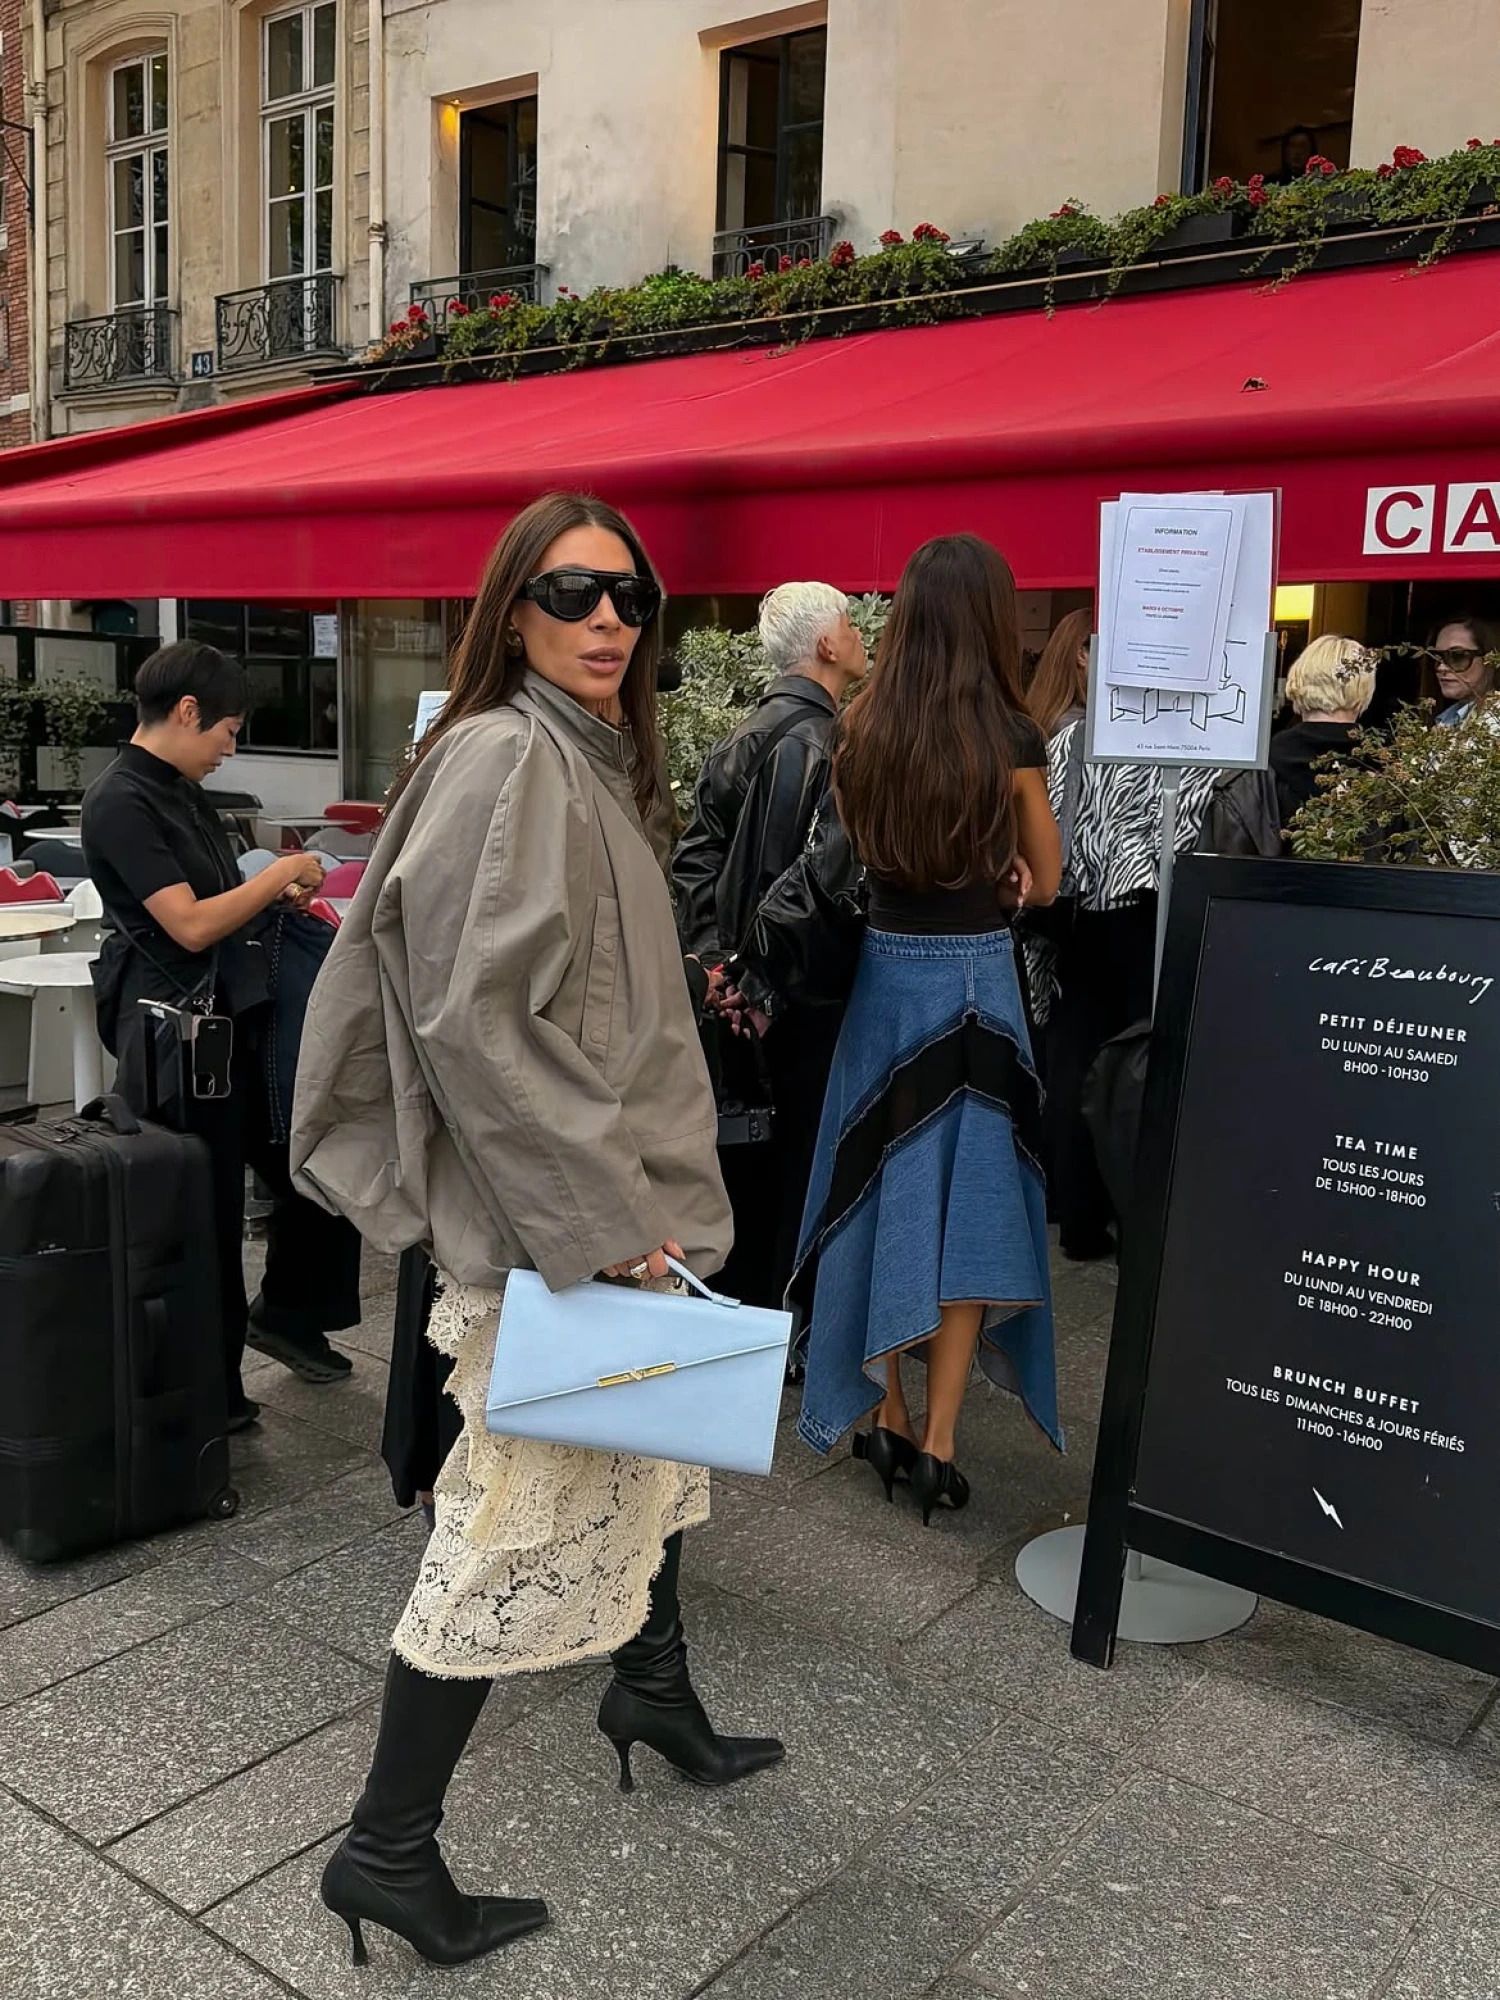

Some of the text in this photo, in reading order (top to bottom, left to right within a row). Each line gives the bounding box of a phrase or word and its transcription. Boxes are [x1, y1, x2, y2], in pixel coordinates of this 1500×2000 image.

[195, 354, 210, 374] 43
[1154, 527, 1198, 536] INFORMATION
[1374, 488, 1500, 549] CA
[1368, 958, 1495, 1005] Beaubourg
[1320, 1013, 1467, 1043] PETIT DÉJEUNER
[1322, 1038, 1458, 1067] DU LUNDI AU SAMEDI
[1336, 1135, 1418, 1160] TEA TIME
[1316, 1177, 1333, 1191] DE
[1323, 1158, 1425, 1187] TOUS LES JOURS
[1302, 1250, 1420, 1287] HAPPY HOUR
[1284, 1272, 1433, 1315] DU LUNDI AU VENDREDI
[1298, 1295, 1315, 1309] DE
[1320, 1299, 1359, 1319] 18H00
[1369, 1311, 1413, 1332] 22H00
[1273, 1366, 1420, 1414] BRUNCH BUFFET
[1227, 1378, 1465, 1453] TOUS LES DIMANCHES & JOURS FÉRIÉS
